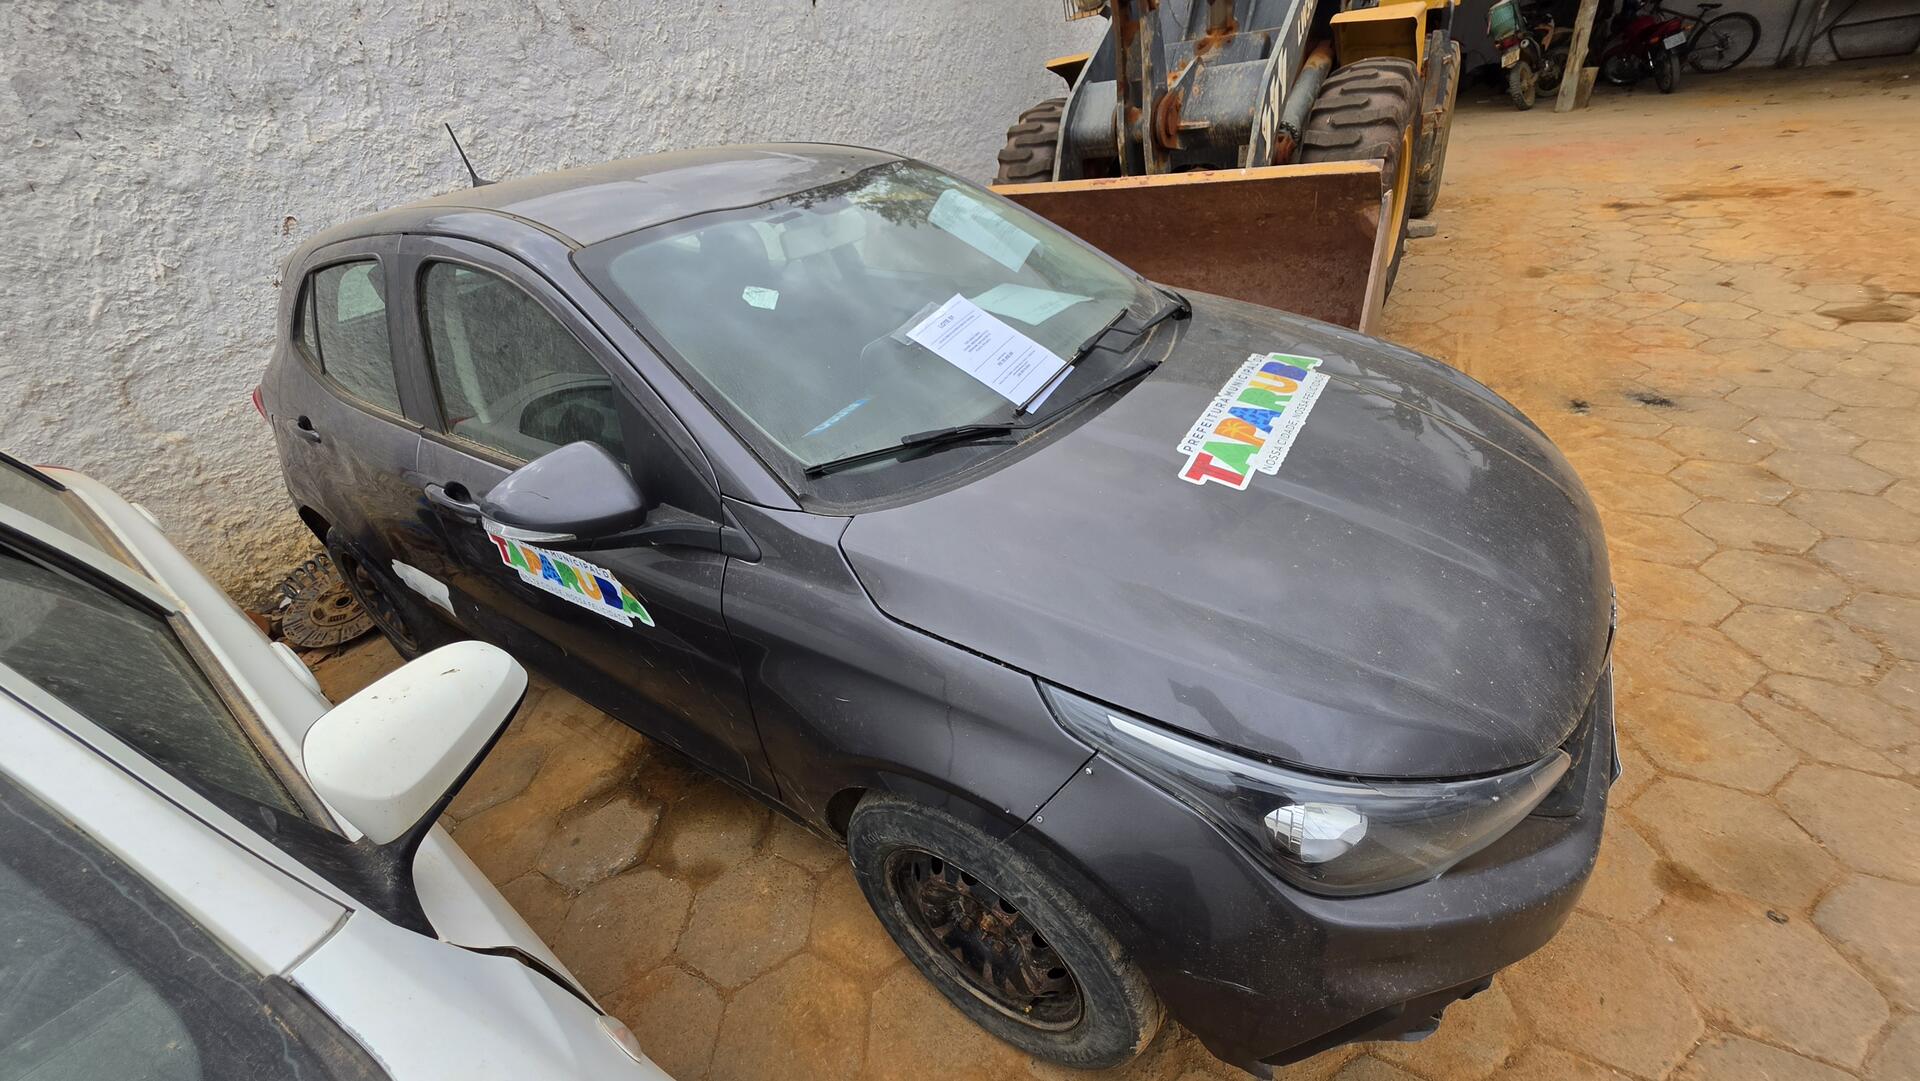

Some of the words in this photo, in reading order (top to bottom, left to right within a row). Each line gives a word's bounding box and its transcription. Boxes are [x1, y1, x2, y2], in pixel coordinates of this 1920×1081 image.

[1183, 398, 1230, 453] PREFEITURA
[1223, 362, 1259, 397] MUNICIPAL
[1185, 354, 1318, 487] TAPARUBA
[1263, 444, 1284, 471] NOSSA
[491, 535, 651, 622] TAPARUBA
[551, 549, 602, 576] MUNICIPAL
